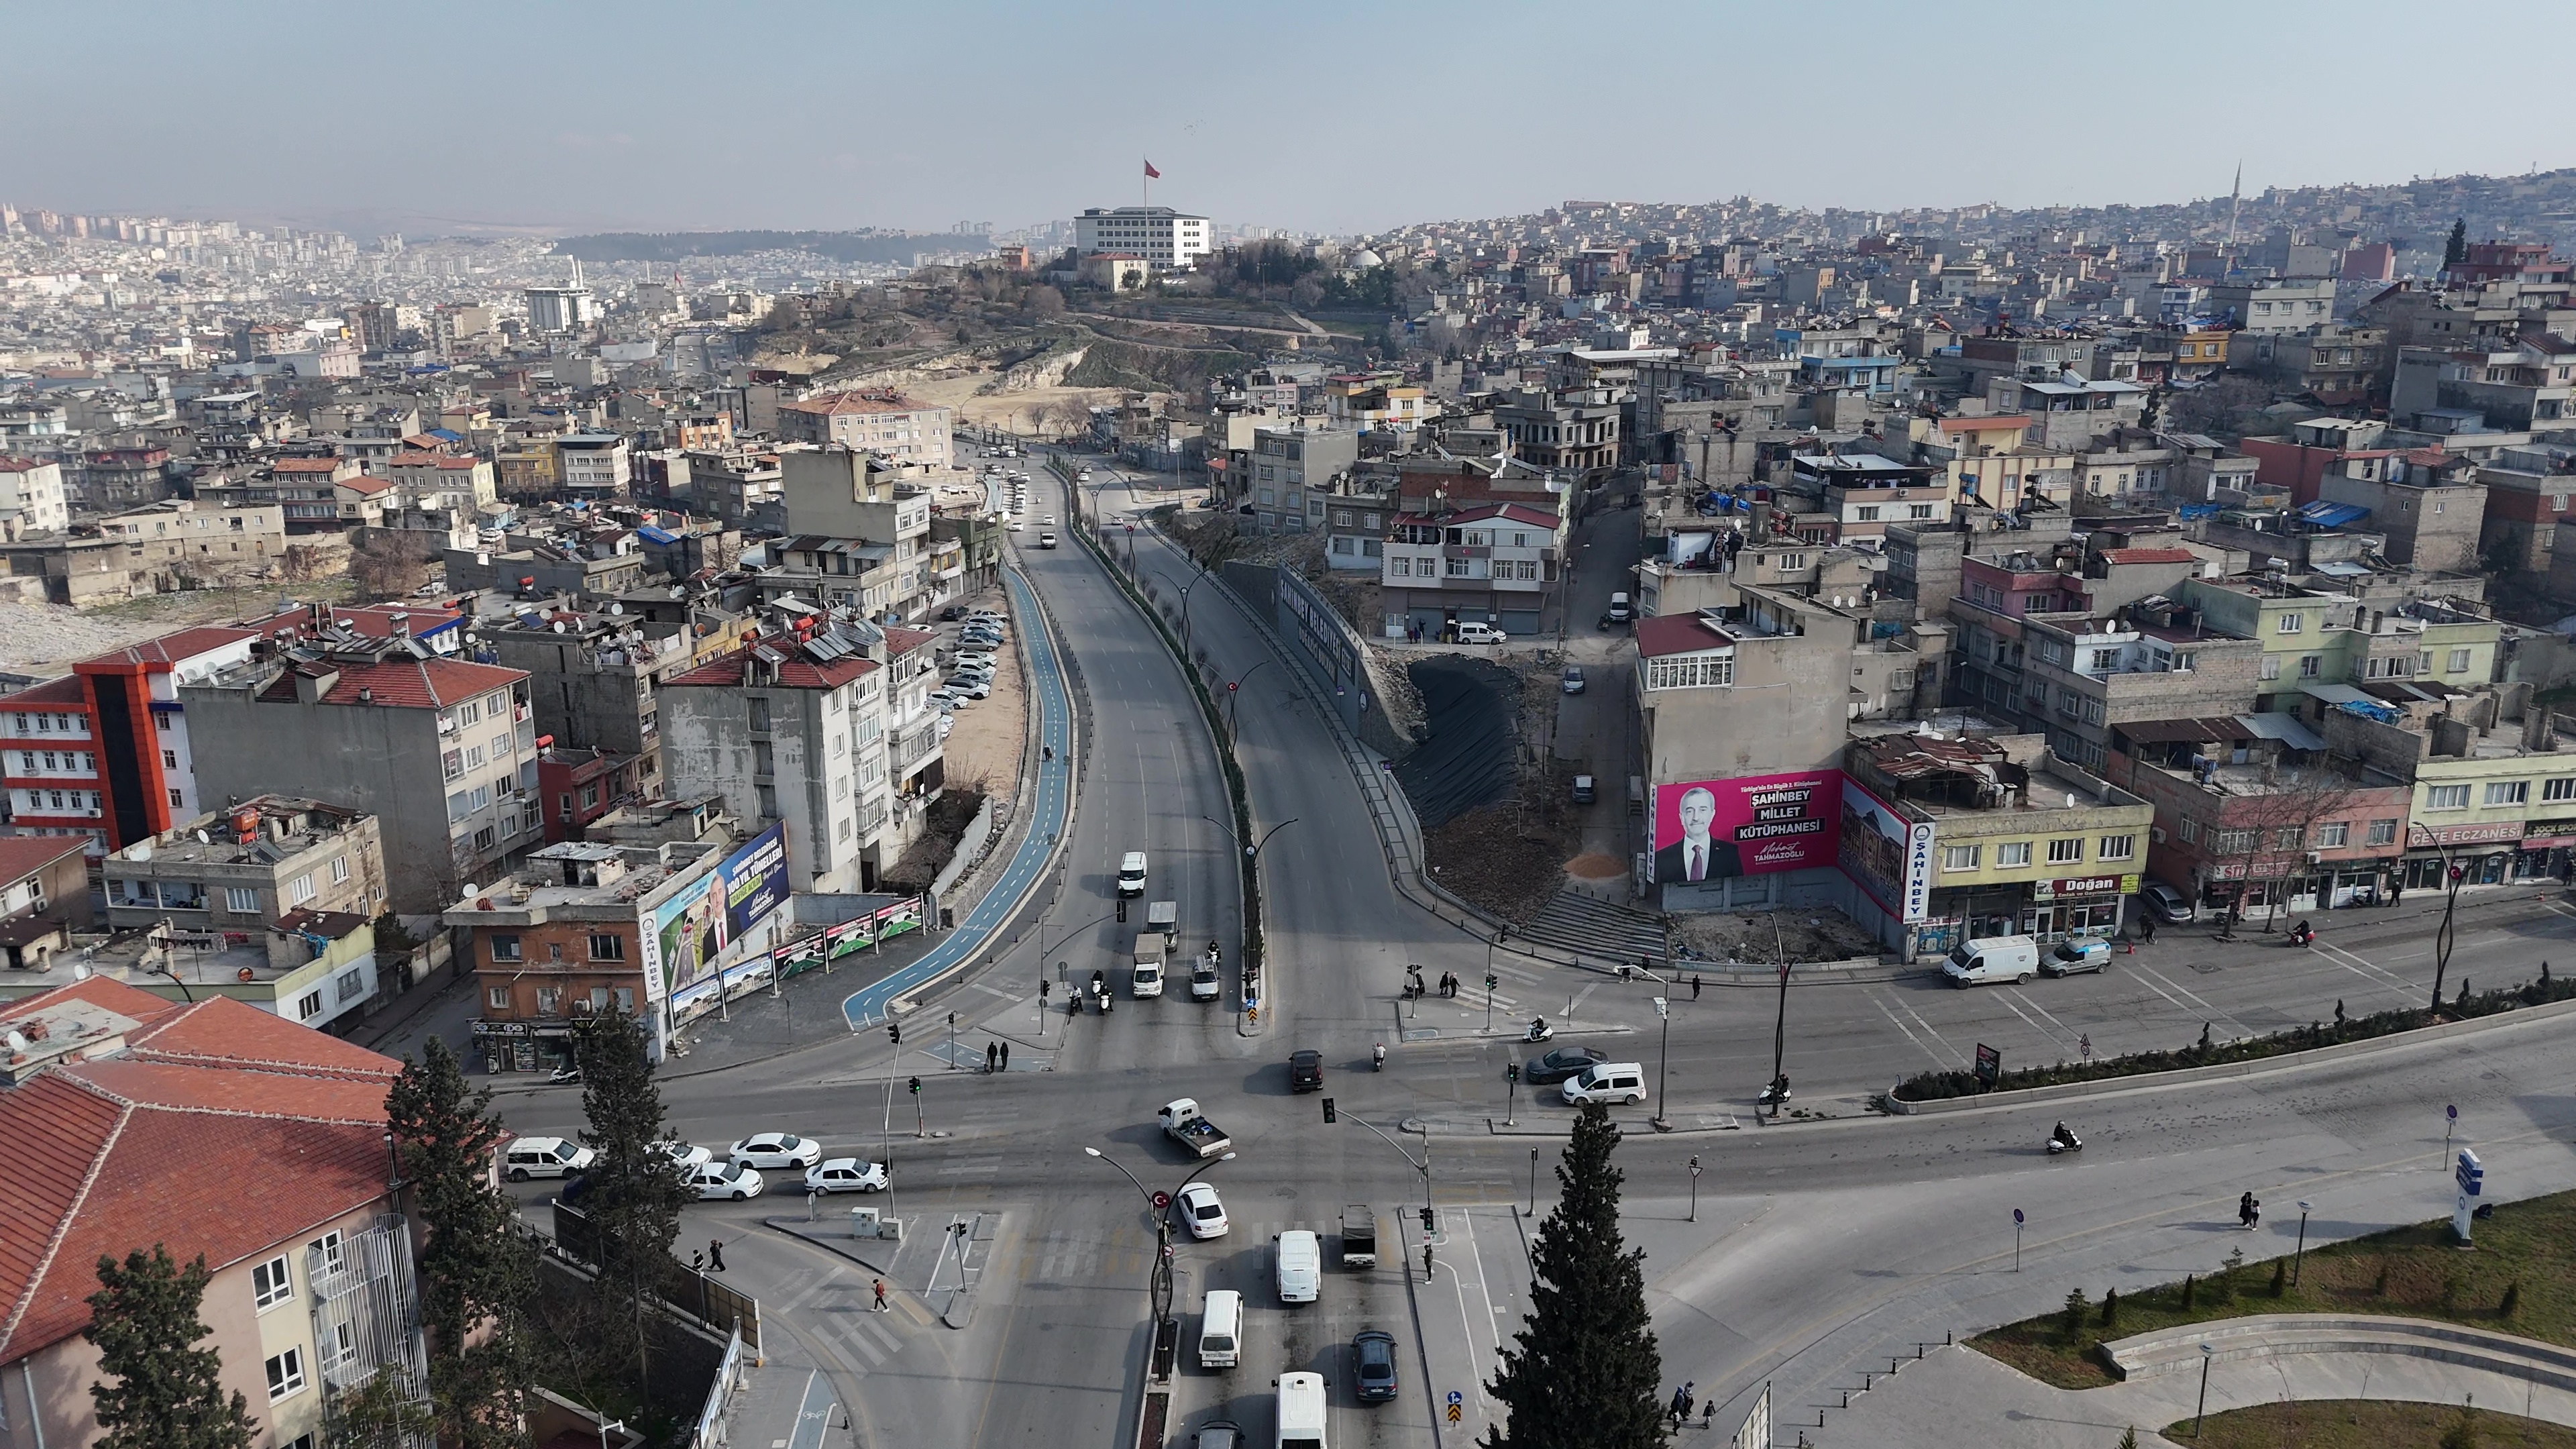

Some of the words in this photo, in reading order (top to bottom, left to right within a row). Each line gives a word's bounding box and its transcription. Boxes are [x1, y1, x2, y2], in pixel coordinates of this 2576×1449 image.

[1309, 606, 1342, 663] BELEDİYESİ
[1752, 790, 1810, 807] ŞAHİNBEY
[1760, 806, 1801, 820] MİLLET
[1739, 819, 1820, 839] KÜTÜPHANESİ
[2412, 832, 2449, 847] ÇETE
[2453, 826, 2521, 841] ECZANESİ
[750, 844, 783, 877] TÜNELLERİ
[1754, 851, 1805, 861] TAHMAZOĞLU
[1911, 842, 1925, 915] ŞAHİNBEY
[2065, 878, 2113, 891] Doğan
[645, 931, 659, 988] ŞAHİNBEY
